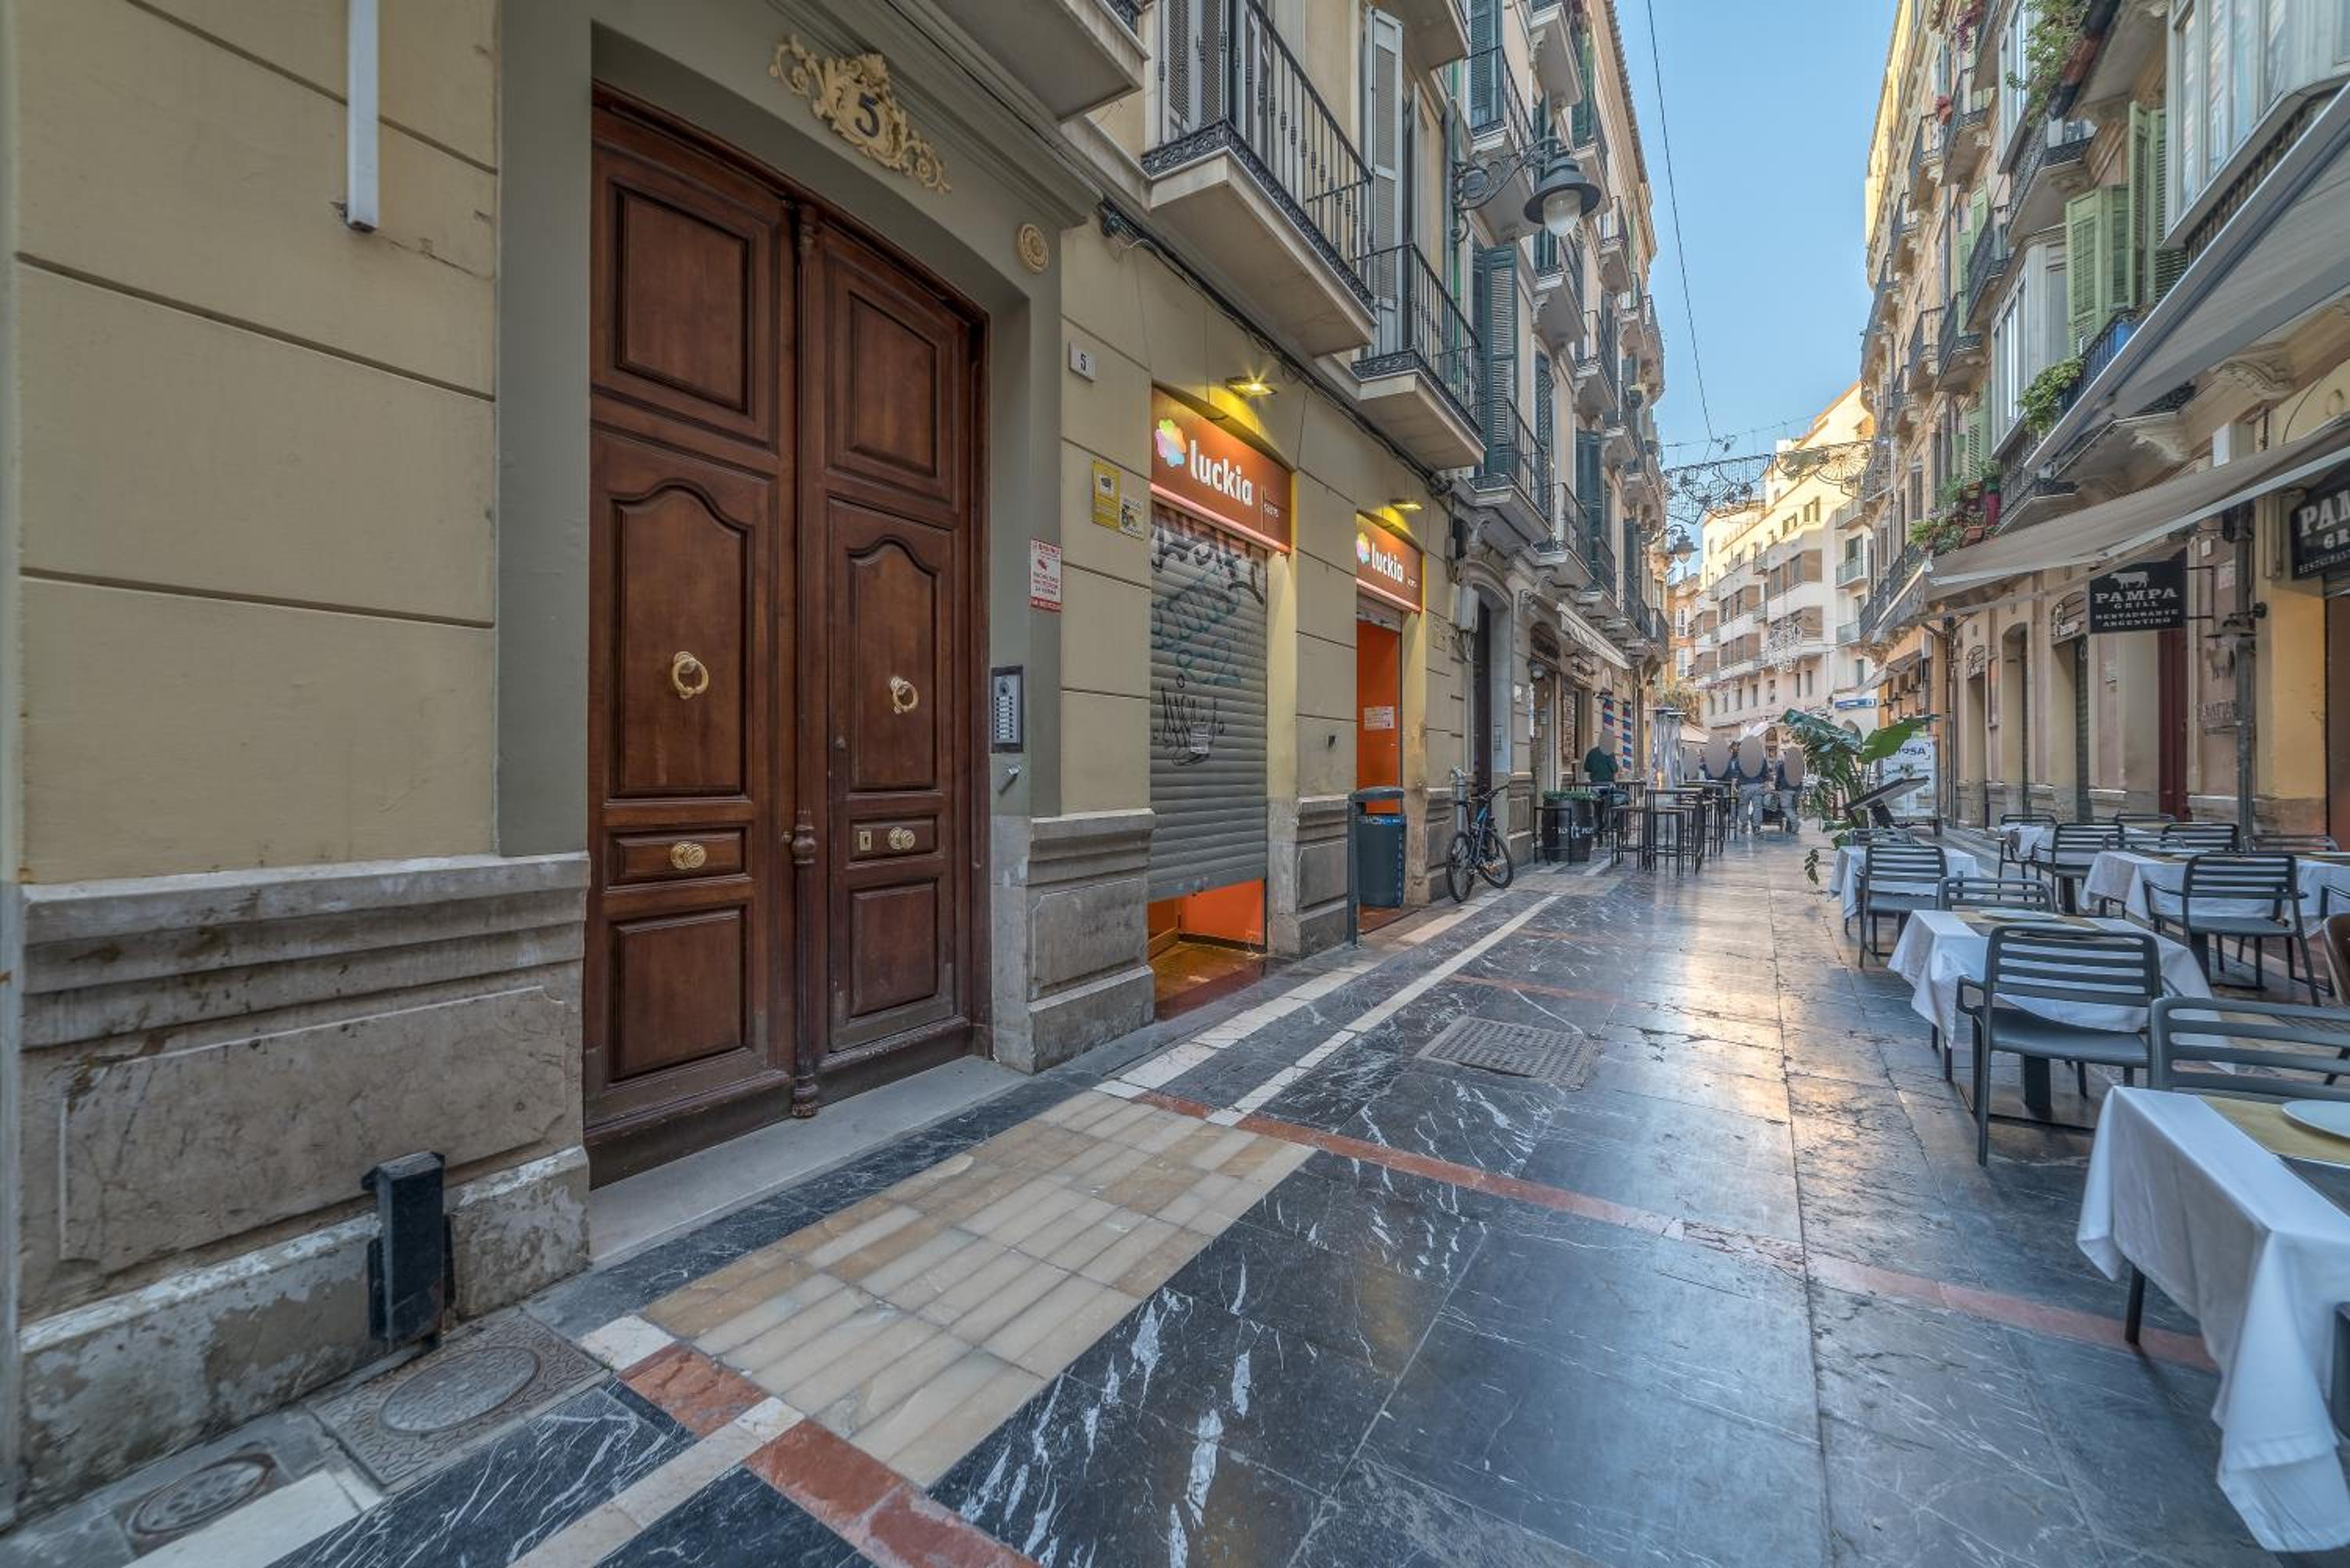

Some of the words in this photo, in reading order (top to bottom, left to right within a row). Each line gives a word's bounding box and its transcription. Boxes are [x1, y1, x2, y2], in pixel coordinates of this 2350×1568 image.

[855, 92, 880, 138] 5
[1079, 352, 1087, 371] 5
[1189, 439, 1253, 507] luckia
[1371, 540, 1404, 583] luckia
[2094, 587, 2178, 604] PAMPA
[2114, 601, 2159, 609] GRILL
[2095, 609, 2178, 620] RESTAURANTE
[2102, 617, 2171, 627] ARGENTINO
